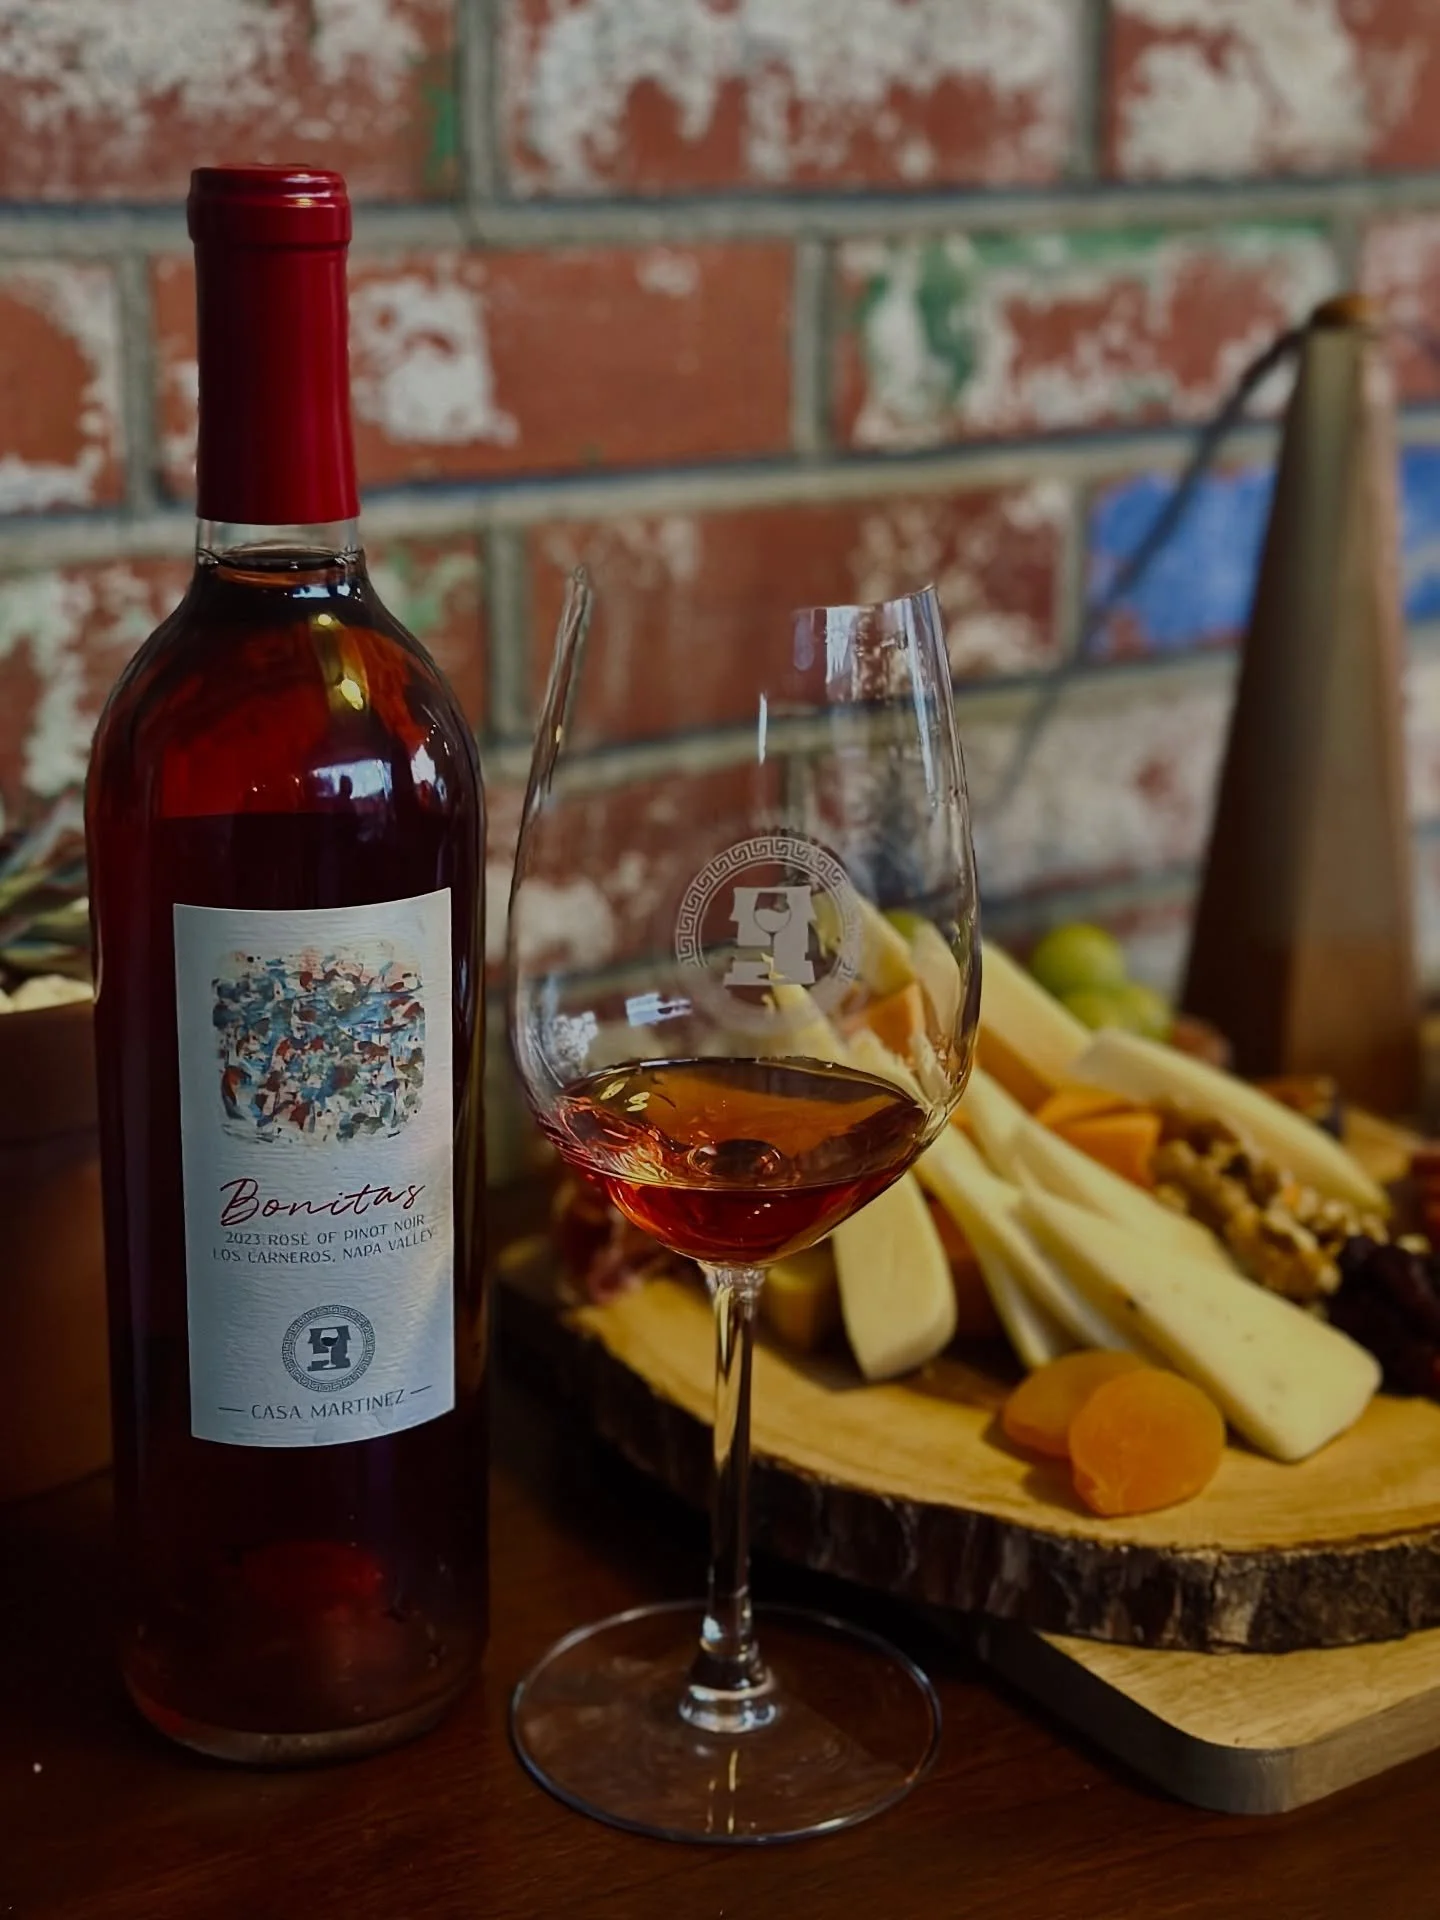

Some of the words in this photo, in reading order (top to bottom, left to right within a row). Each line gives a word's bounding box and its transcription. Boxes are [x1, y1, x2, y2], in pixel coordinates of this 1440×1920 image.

[220, 1178, 426, 1226] Bonitas
[212, 1248, 241, 1262] LOS
[343, 1240, 382, 1258] NAPA
[389, 1229, 435, 1251] VALLEY
[225, 1232, 260, 1245] 2023
[317, 1230, 338, 1245] OF
[344, 1224, 388, 1241] PINOT
[394, 1214, 425, 1231] NOIR
[251, 1404, 303, 1420] CASA
[311, 1388, 405, 1417] MARTINEZ
